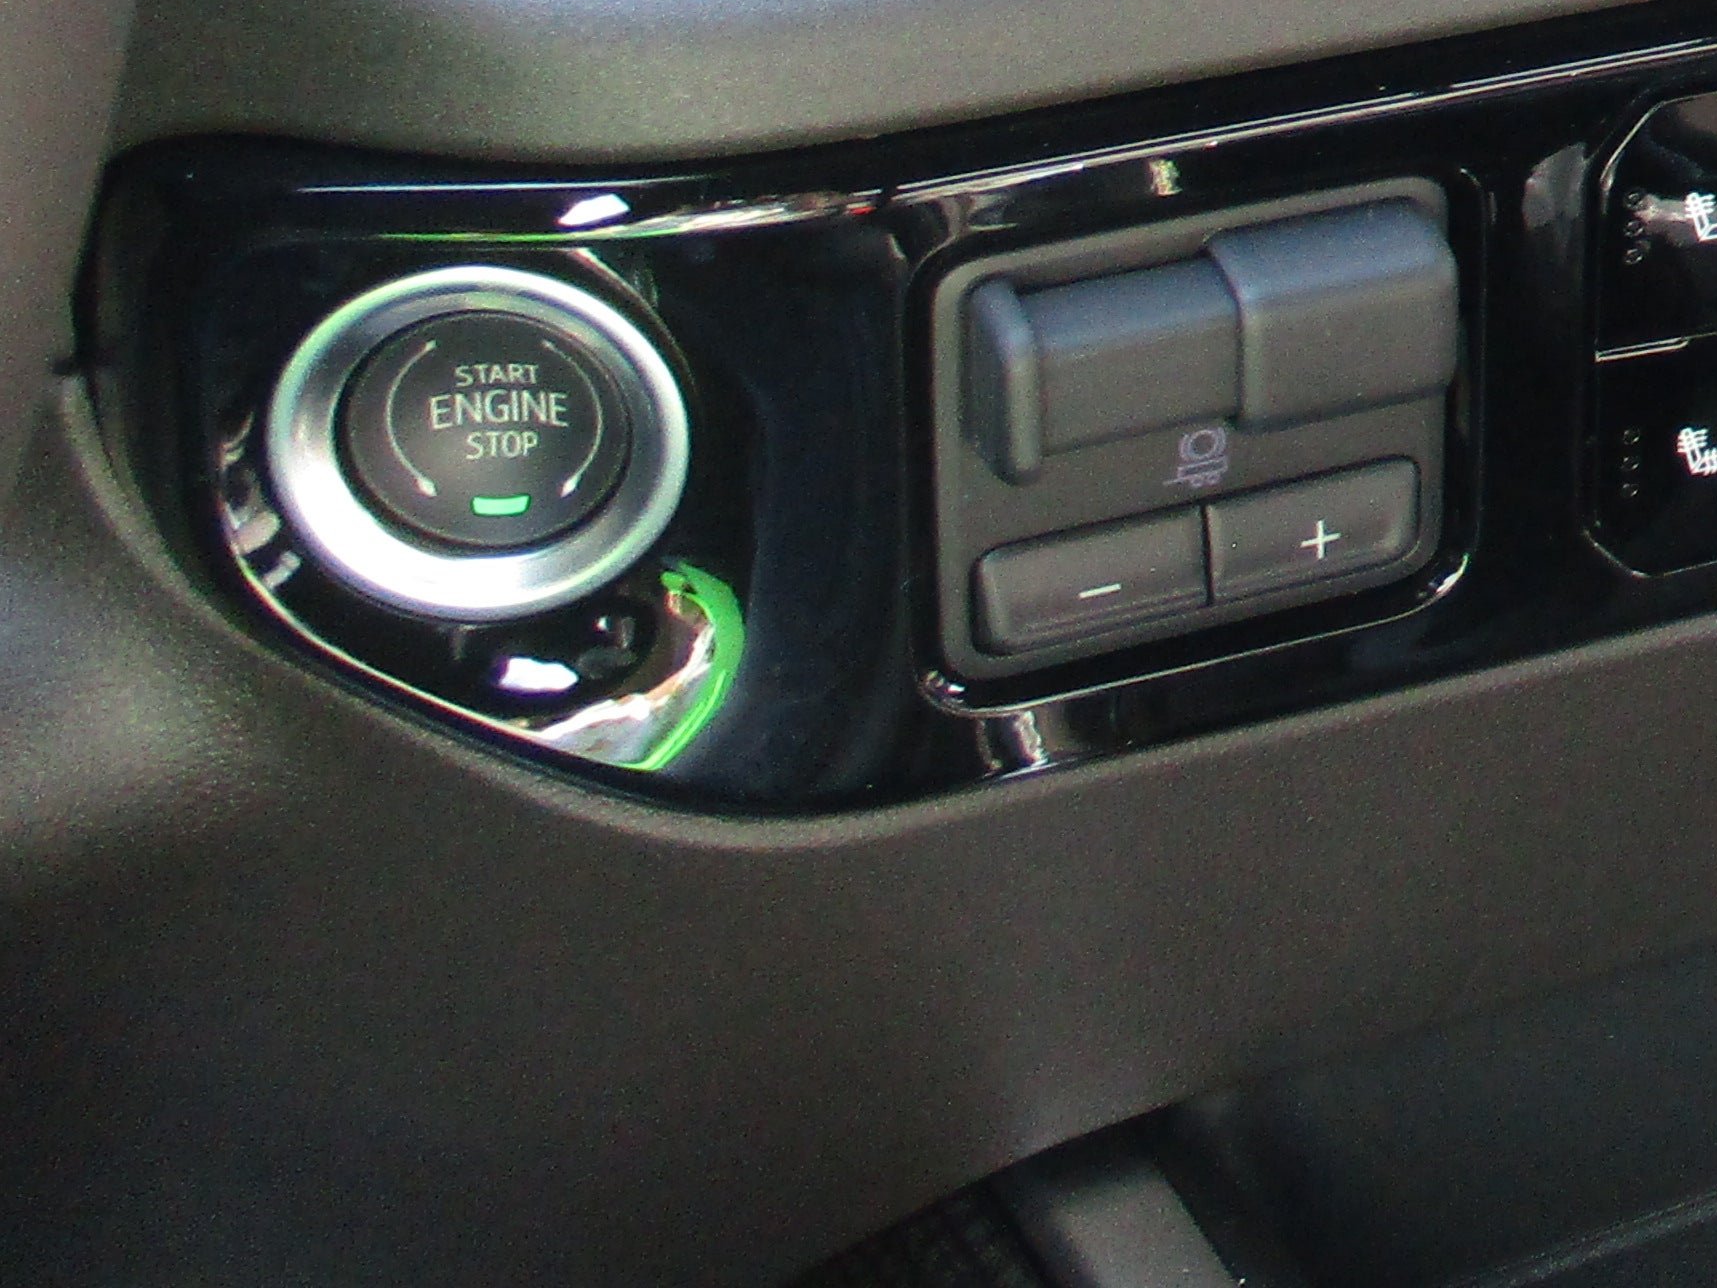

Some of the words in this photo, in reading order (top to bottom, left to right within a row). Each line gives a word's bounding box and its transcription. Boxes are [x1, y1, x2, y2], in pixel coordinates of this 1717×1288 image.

[453, 363, 539, 387] START
[429, 388, 569, 430] ENGINE
[465, 430, 539, 460] STOP
